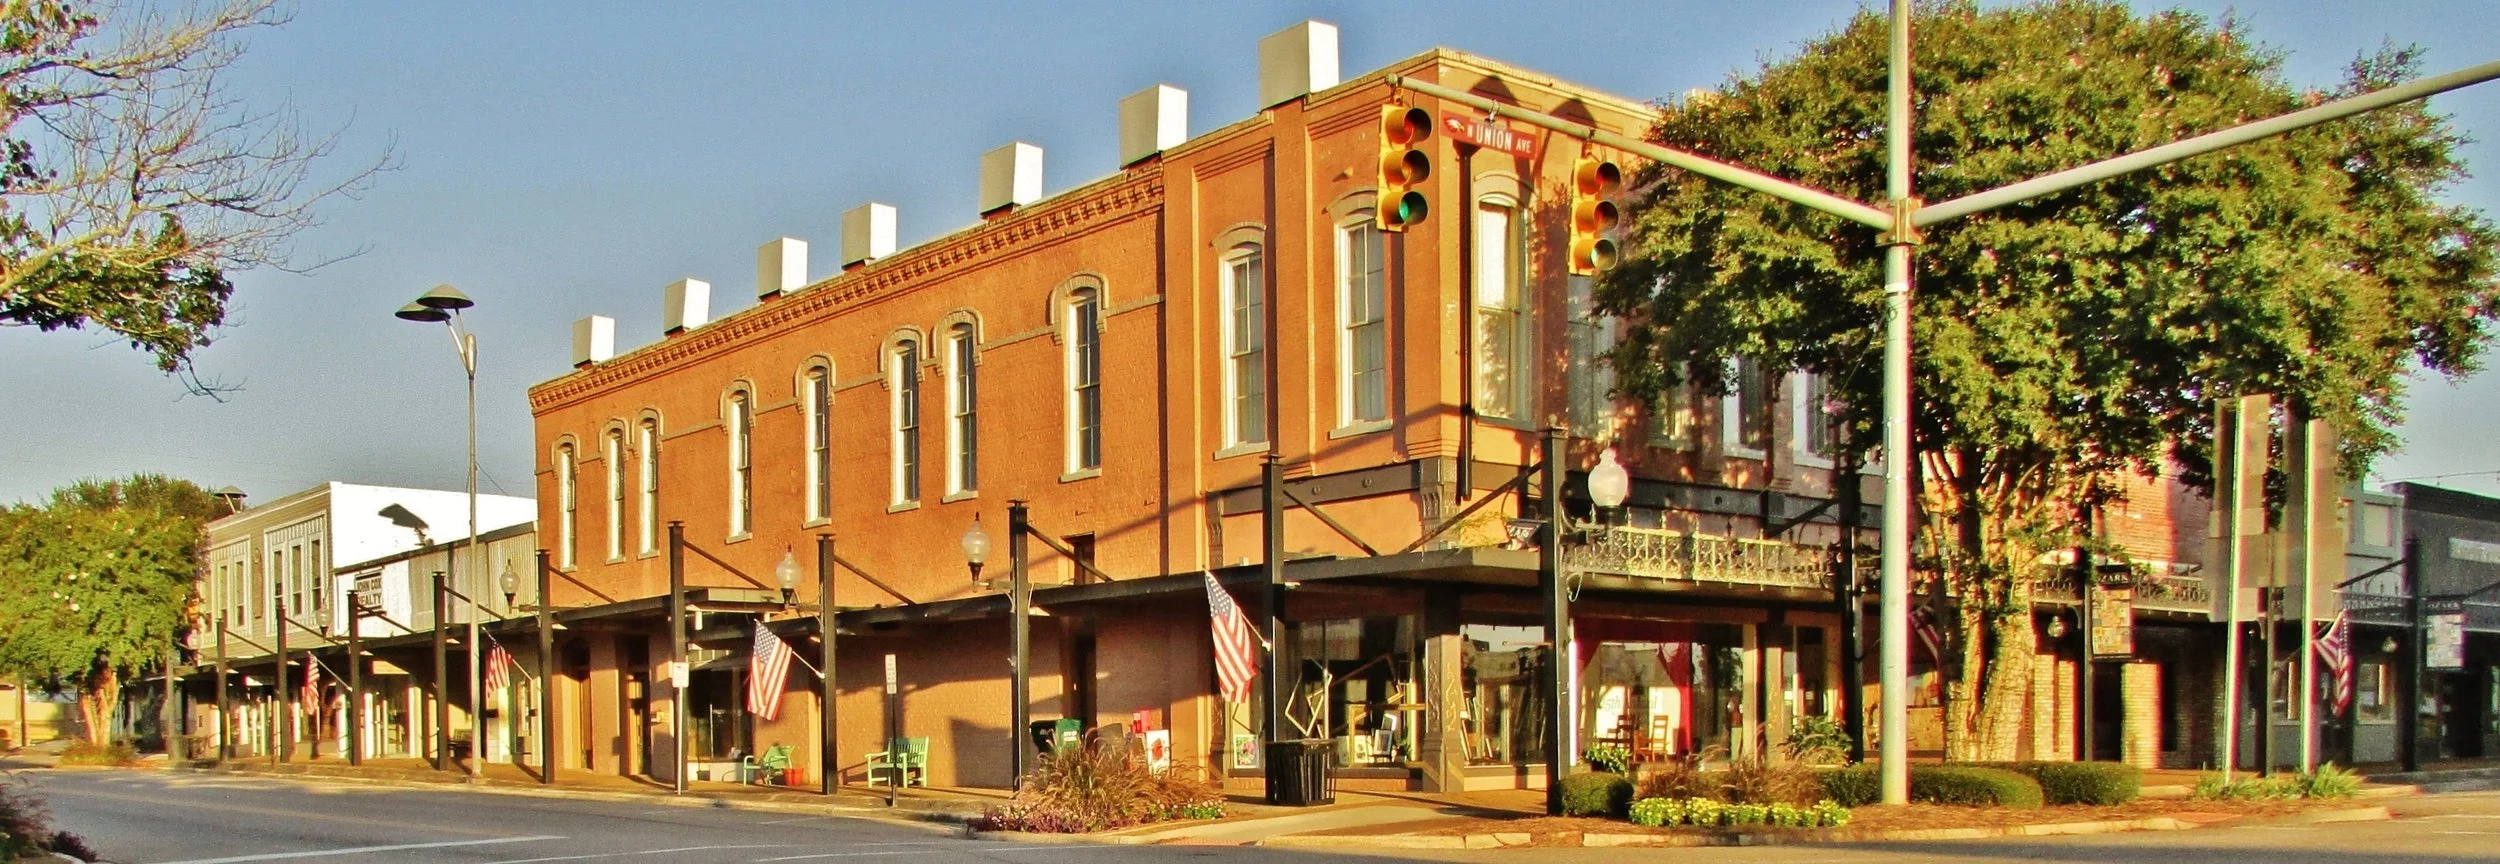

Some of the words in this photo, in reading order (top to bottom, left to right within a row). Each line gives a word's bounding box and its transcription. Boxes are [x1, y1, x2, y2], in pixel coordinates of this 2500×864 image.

[1467, 124, 1474, 138] N
[1476, 124, 1512, 152] UNION
[1516, 138, 1531, 154] AVE
